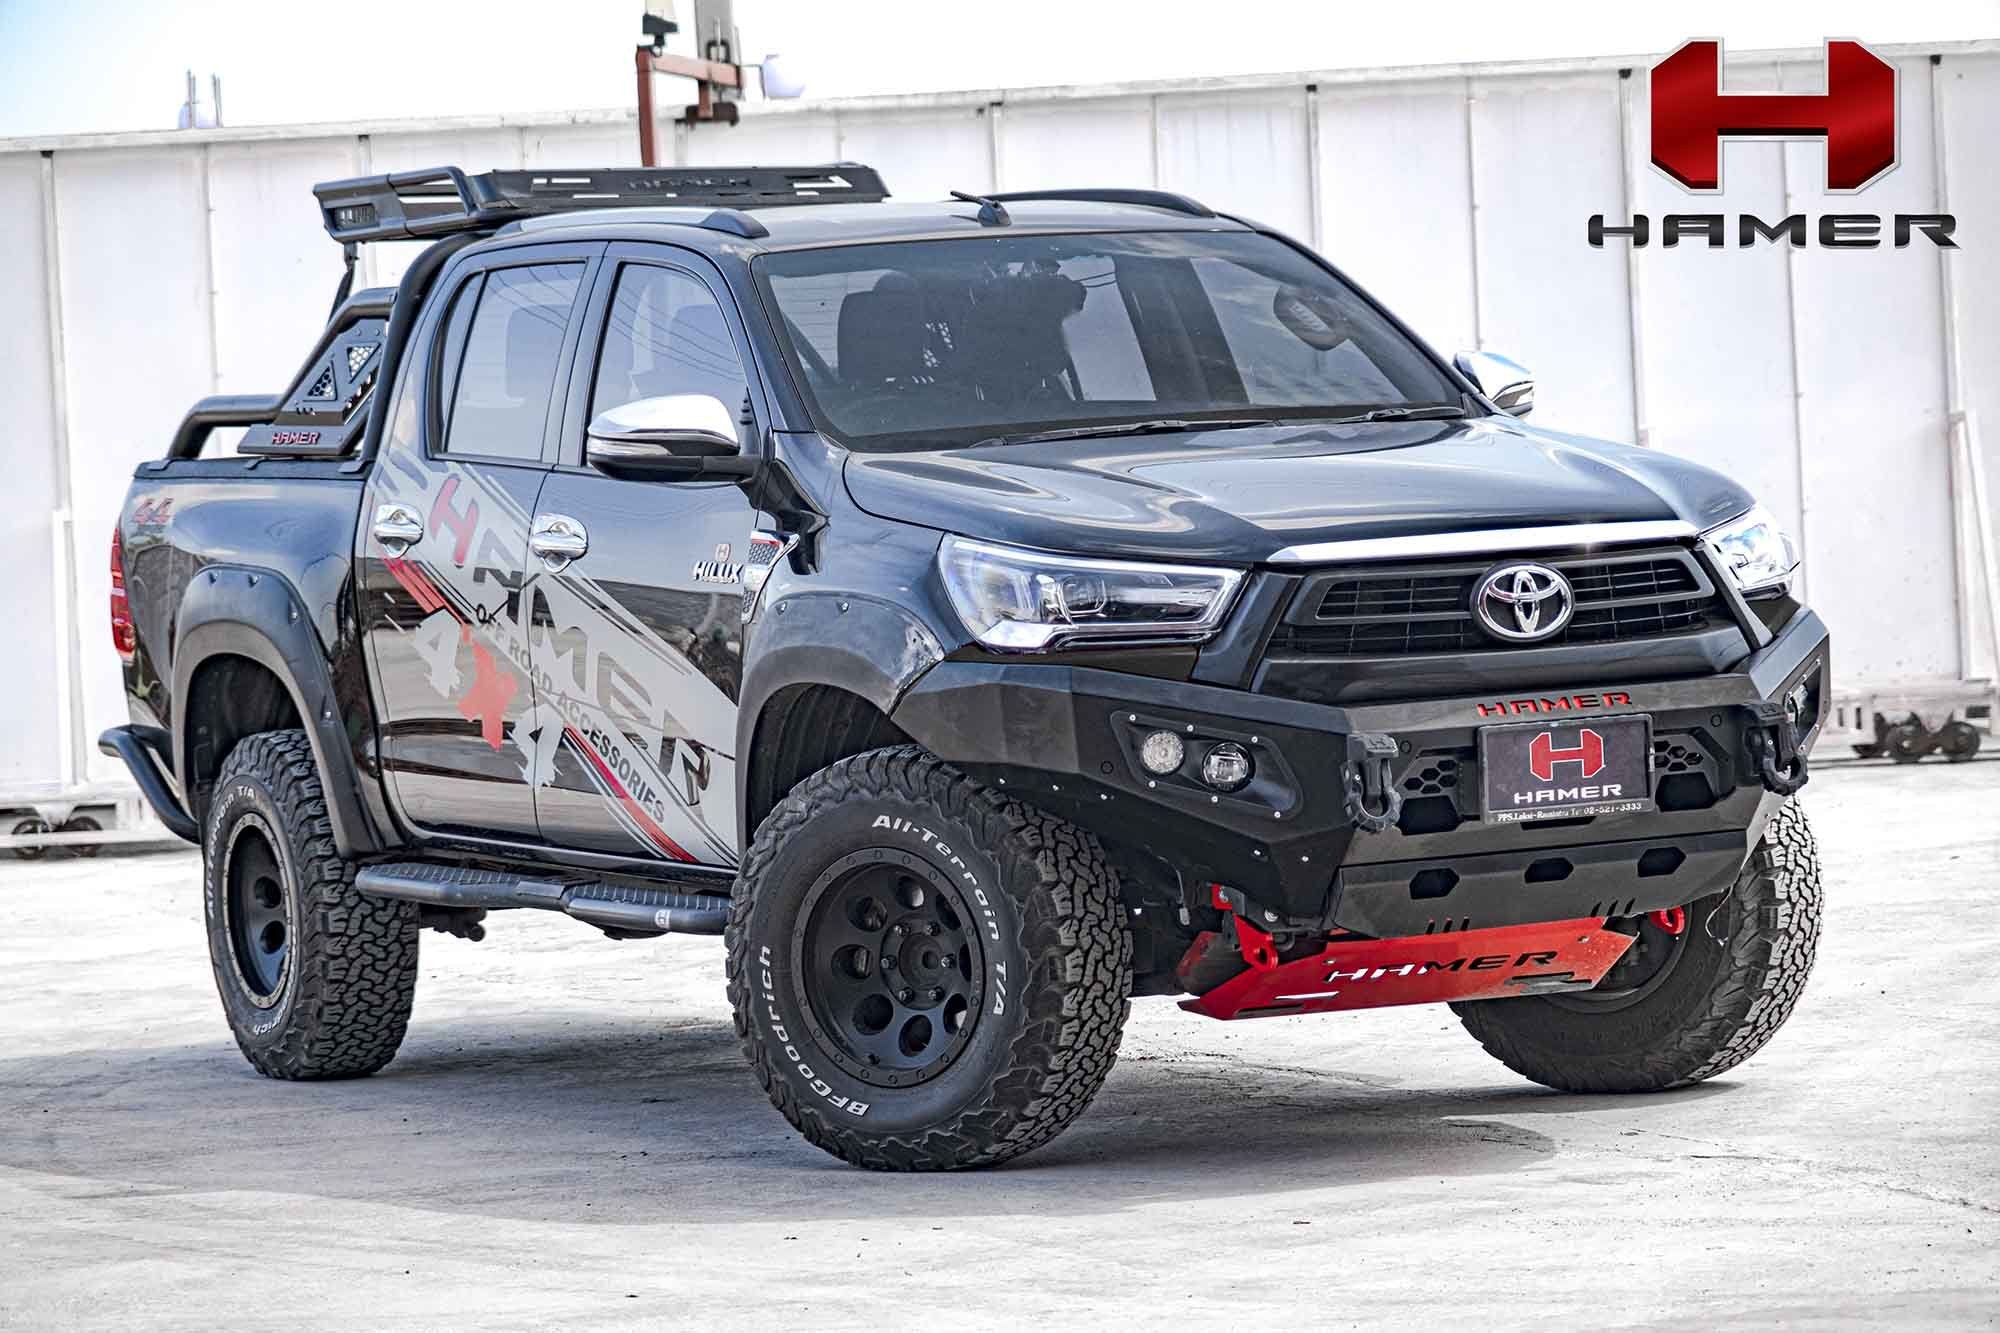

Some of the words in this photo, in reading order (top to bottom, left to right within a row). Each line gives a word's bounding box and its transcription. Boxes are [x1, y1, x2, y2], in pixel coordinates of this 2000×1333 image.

[271, 431, 321, 446] HAMER
[693, 560, 744, 584] HILUX
[1476, 691, 1633, 718] HAMER
[508, 636, 553, 693] ROAD
[556, 690, 666, 824] ACCESSORIES
[1513, 784, 1623, 804] HAMER
[871, 814, 1001, 941] All-Terrain
[992, 959, 1008, 1017] T/A
[1323, 950, 1558, 984] HAMER
[758, 945, 871, 1117] BFGoodrich
